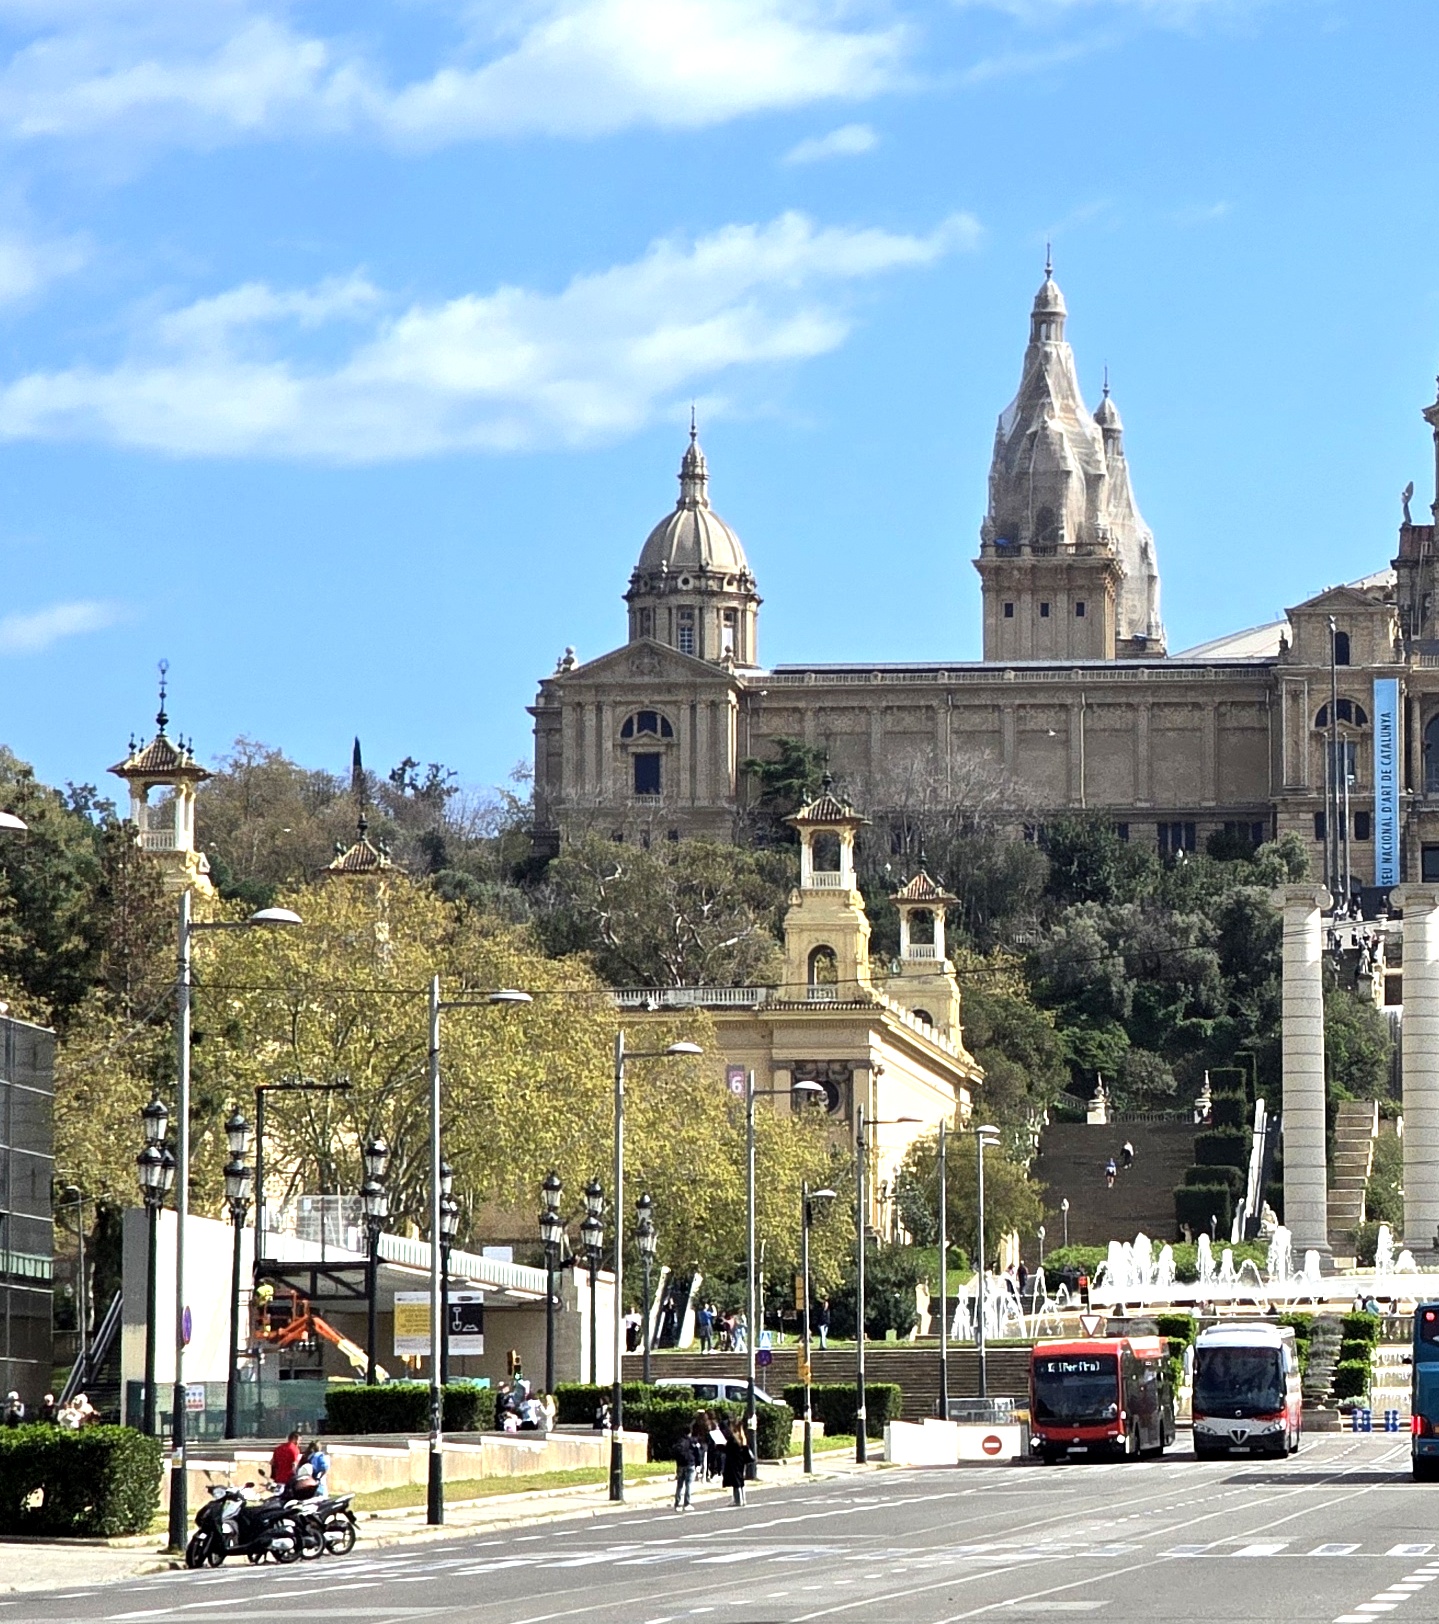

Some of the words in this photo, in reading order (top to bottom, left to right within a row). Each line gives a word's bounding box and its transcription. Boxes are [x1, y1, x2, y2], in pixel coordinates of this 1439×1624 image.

[1380, 711, 1392, 766] CATALUNYA
[1381, 769, 1392, 782] DE
[1381, 785, 1393, 813] D'ART
[1381, 817, 1393, 864] NACIONAL
[1381, 868, 1393, 886] SEU
[731, 1076, 743, 1093] 6
